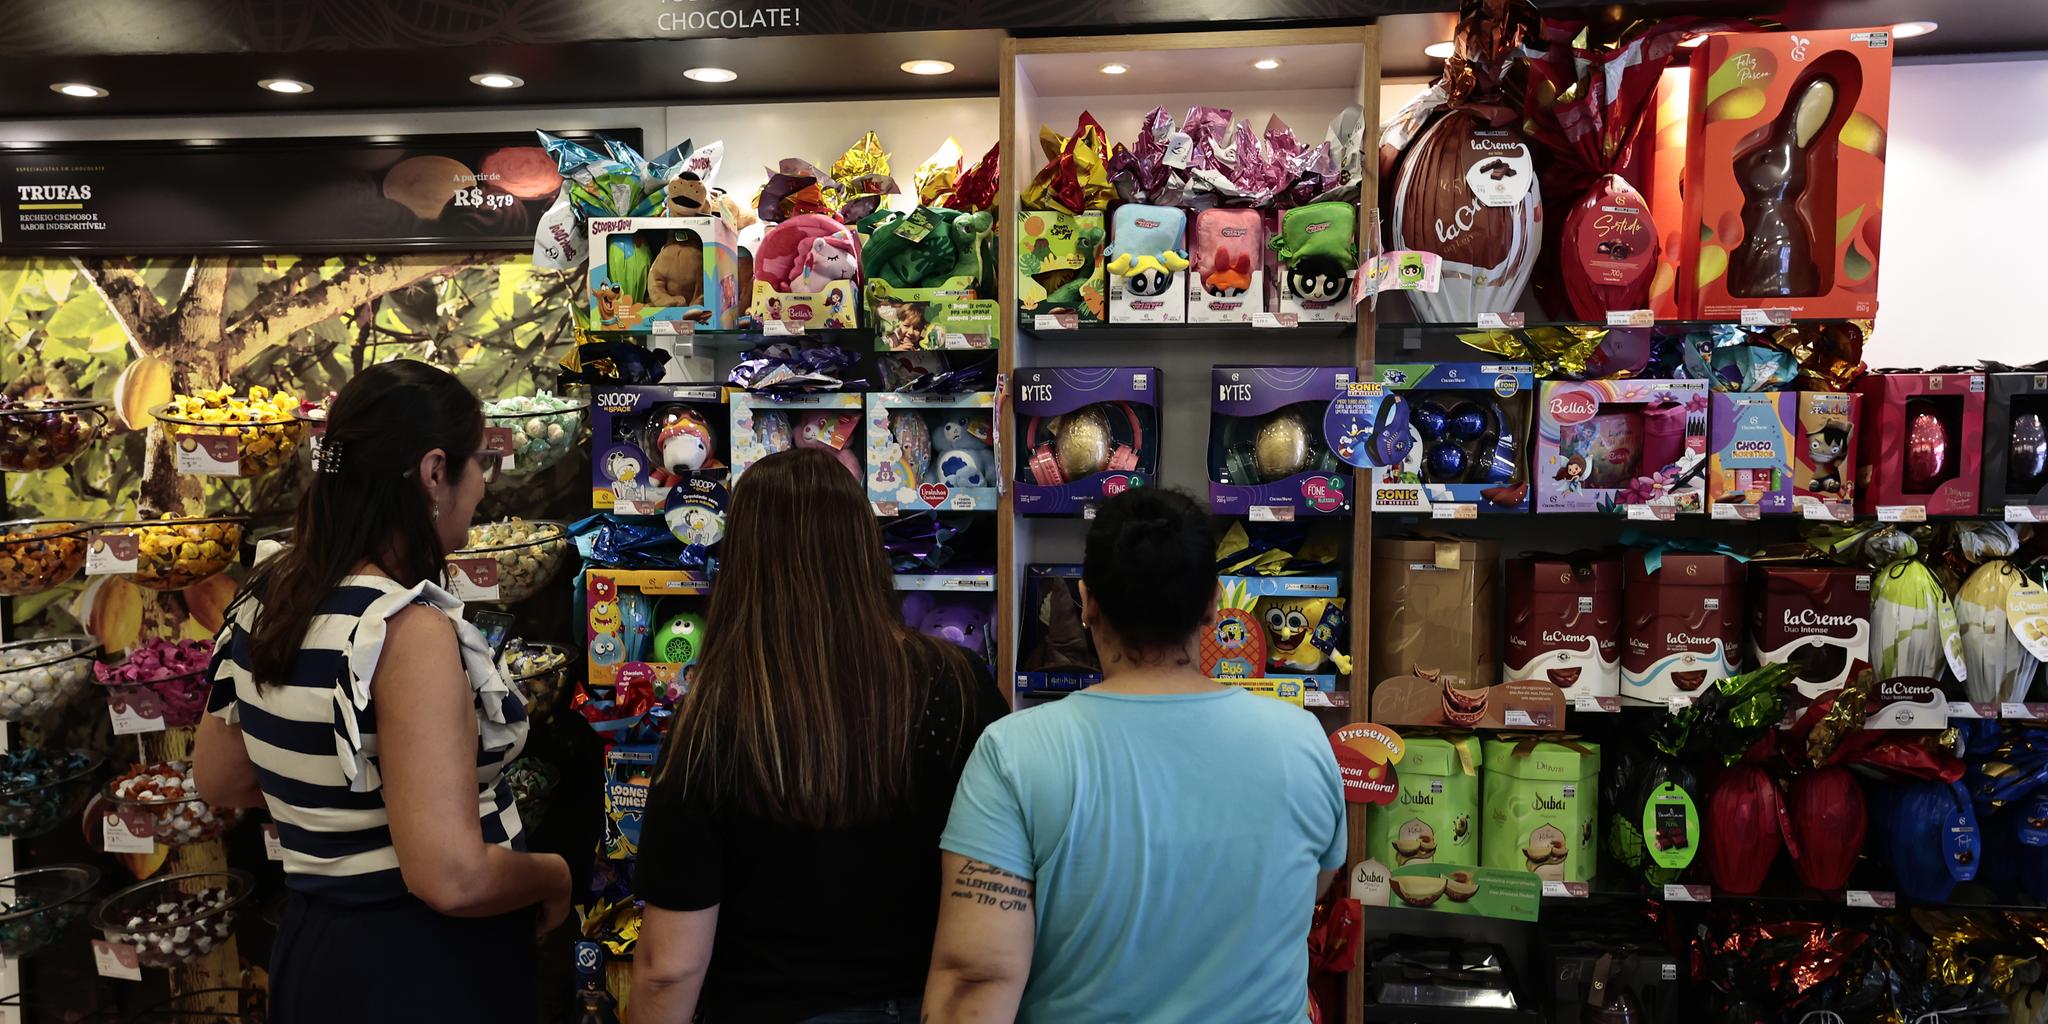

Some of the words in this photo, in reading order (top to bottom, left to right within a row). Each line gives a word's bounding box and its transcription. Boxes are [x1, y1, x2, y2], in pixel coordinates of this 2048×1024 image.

[658, 8, 800, 31] CHOCOLATE!
[1471, 139, 1517, 151] laCreme
[453, 174, 460, 182] A
[461, 173, 488, 184] partir
[489, 172, 501, 181] de
[17, 185, 92, 201] TRUFAS
[454, 188, 484, 208] R$
[486, 194, 514, 210] 3,79
[20, 214, 53, 222] RECHEIO
[54, 213, 92, 221] CREMOSO
[93, 213, 98, 221] E
[20, 223, 45, 231] SABOR
[46, 221, 106, 230] INDESCRITÍVEL!
[1593, 214, 1642, 238] Sortido
[1021, 384, 1052, 401] BYTES
[1219, 384, 1251, 401] BYTES
[1349, 383, 1381, 391] SONIC
[598, 393, 641, 408] SNOOPY
[1550, 398, 1598, 415] Bella's
[1736, 441, 1771, 451] CHOCO
[690, 479, 716, 490] SNOOPY
[1308, 485, 1325, 496] FONE
[1377, 489, 1419, 500] SONIC
[1784, 608, 1853, 626] laCreme
[1784, 625, 1799, 633] Duo
[1800, 625, 1829, 633] Intense
[1543, 630, 1586, 643] laCreme
[1667, 633, 1712, 645] laCreme
[1881, 682, 1931, 695] laCreme
[1338, 728, 1401, 756] Presentes
[1342, 778, 1395, 793] cantadora!
[613, 795, 647, 808] TUNES
[1400, 786, 1434, 806] Dubai
[1532, 791, 1566, 811] Dubai
[1357, 868, 1384, 884] Dubai
[580, 951, 596, 963] DC
